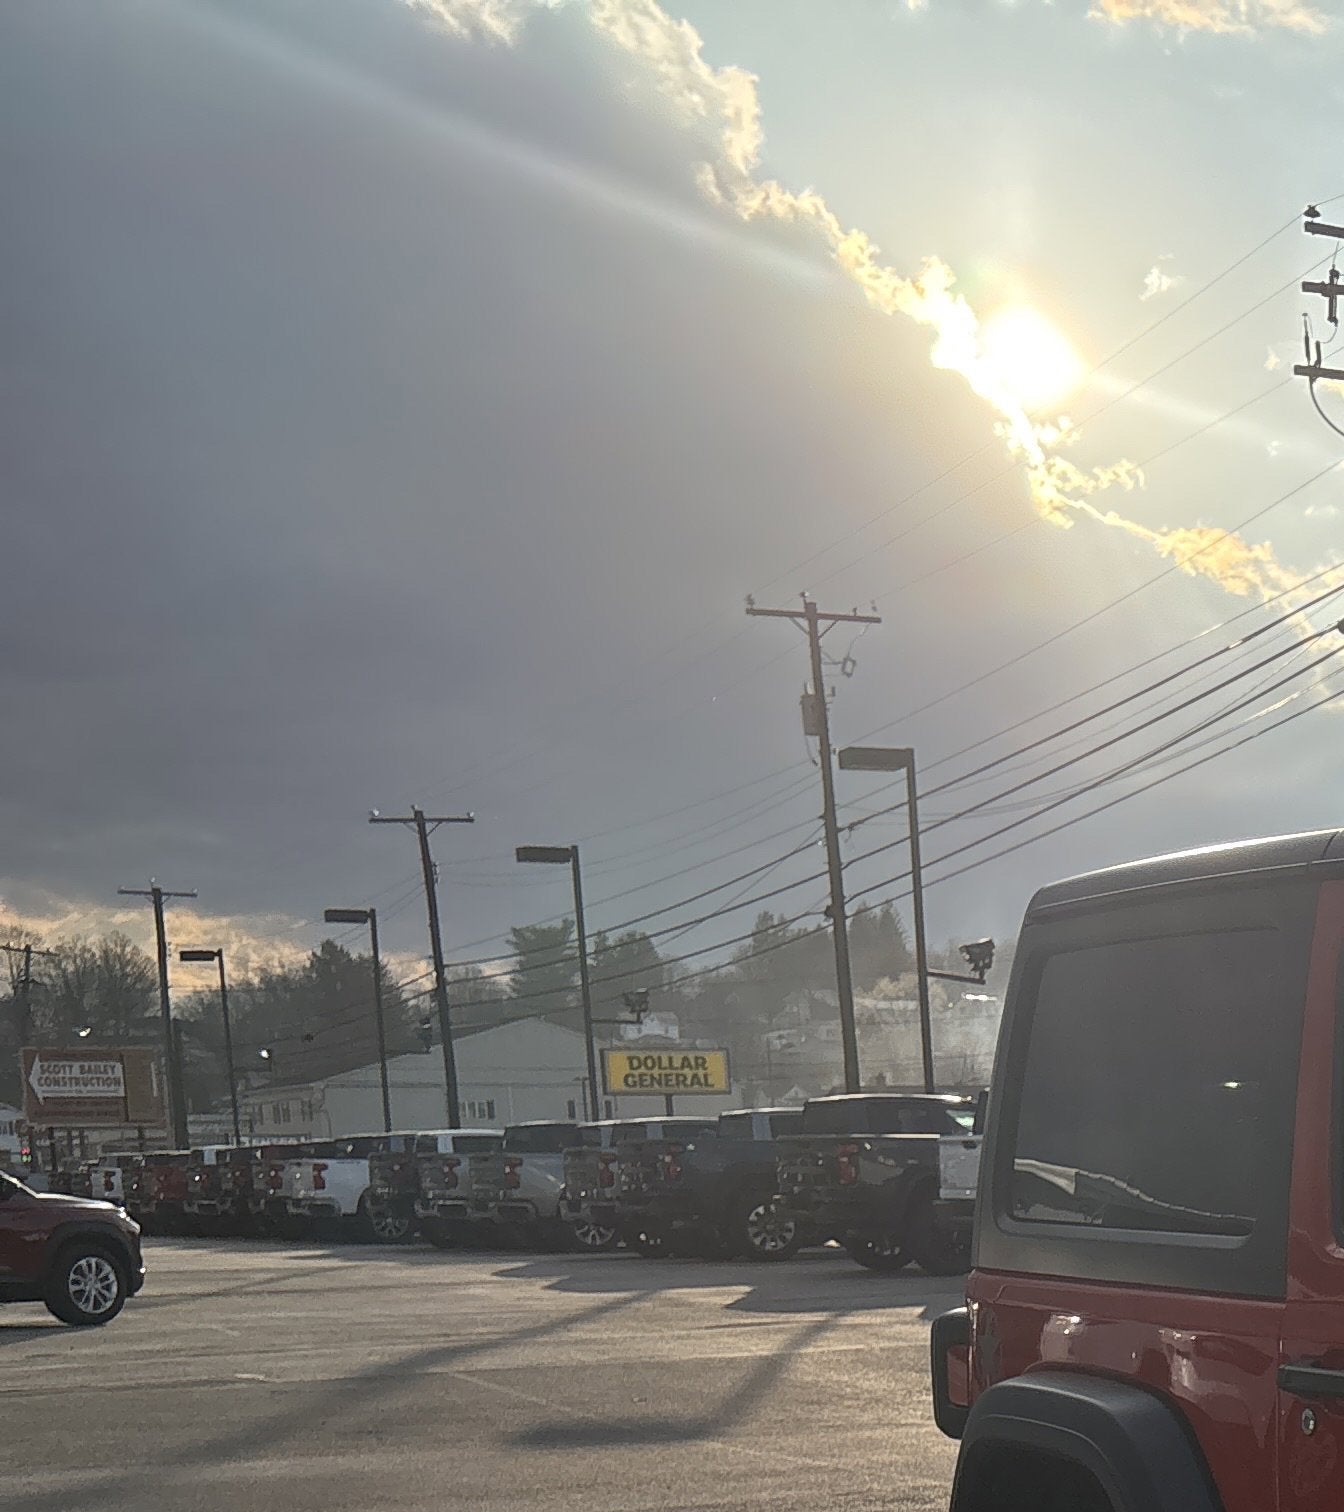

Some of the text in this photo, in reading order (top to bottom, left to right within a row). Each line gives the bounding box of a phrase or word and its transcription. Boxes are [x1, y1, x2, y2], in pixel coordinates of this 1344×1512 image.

[39, 1063, 116, 1075] SCOTT BAILEY
[626, 1055, 708, 1071] DOLLAR
[37, 1075, 121, 1088] CONSTRUCTION
[623, 1073, 715, 1088] GENERAL
